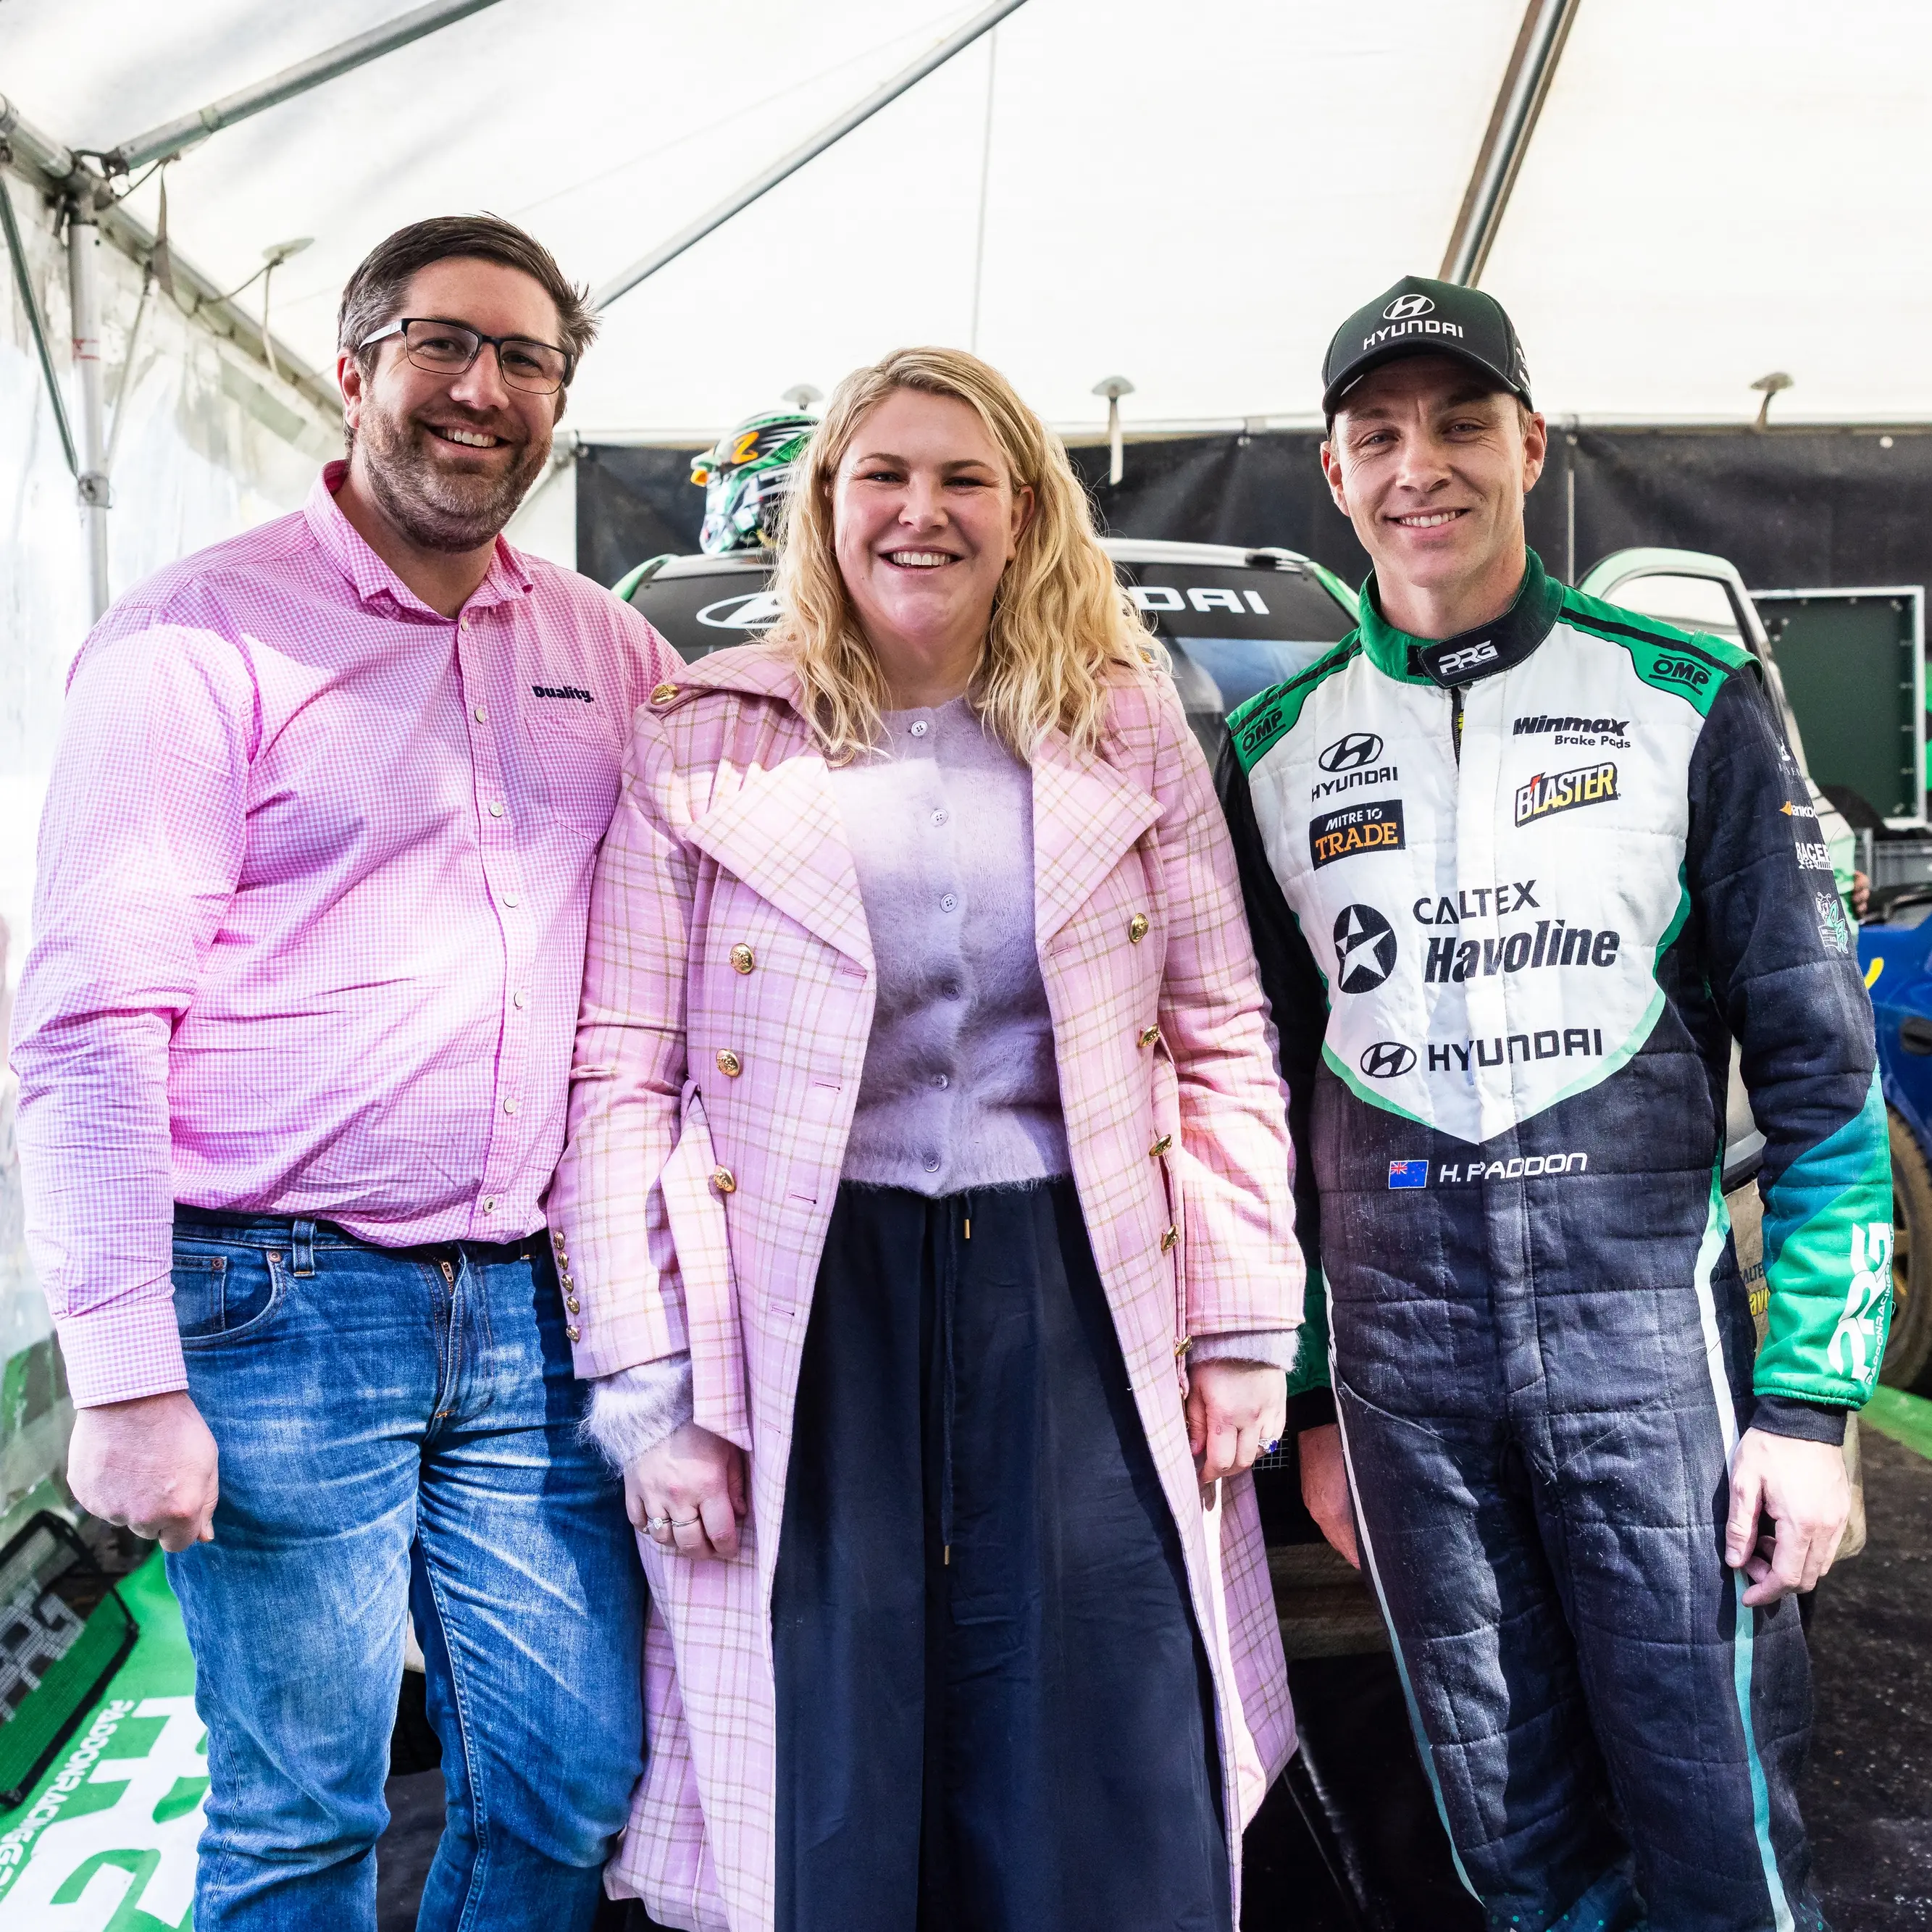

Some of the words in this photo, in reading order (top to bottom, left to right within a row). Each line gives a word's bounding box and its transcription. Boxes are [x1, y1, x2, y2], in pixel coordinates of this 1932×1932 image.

[1363, 319, 1463, 351] HYUNDAI
[1439, 640, 1498, 674] PRG
[1653, 659, 1709, 685] OMP
[1242, 710, 1283, 752] OMP
[1513, 715, 1630, 737] Winmax
[1555, 735, 1596, 746] Brake
[1600, 735, 1631, 749] Pads
[1311, 766, 1398, 803] HYUNDAI
[1325, 810, 1363, 832] MITRE
[1366, 808, 1383, 821] 10
[1315, 822, 1398, 861] TRADE
[1413, 879, 1541, 925] CALTEX
[1424, 919, 1621, 984] Havoline
[1428, 1028, 1603, 1072] HYUNDAI
[1439, 1164, 1461, 1183] H.
[1466, 1153, 1588, 1182] PADDON
[1826, 1222, 1890, 1382] PRG
